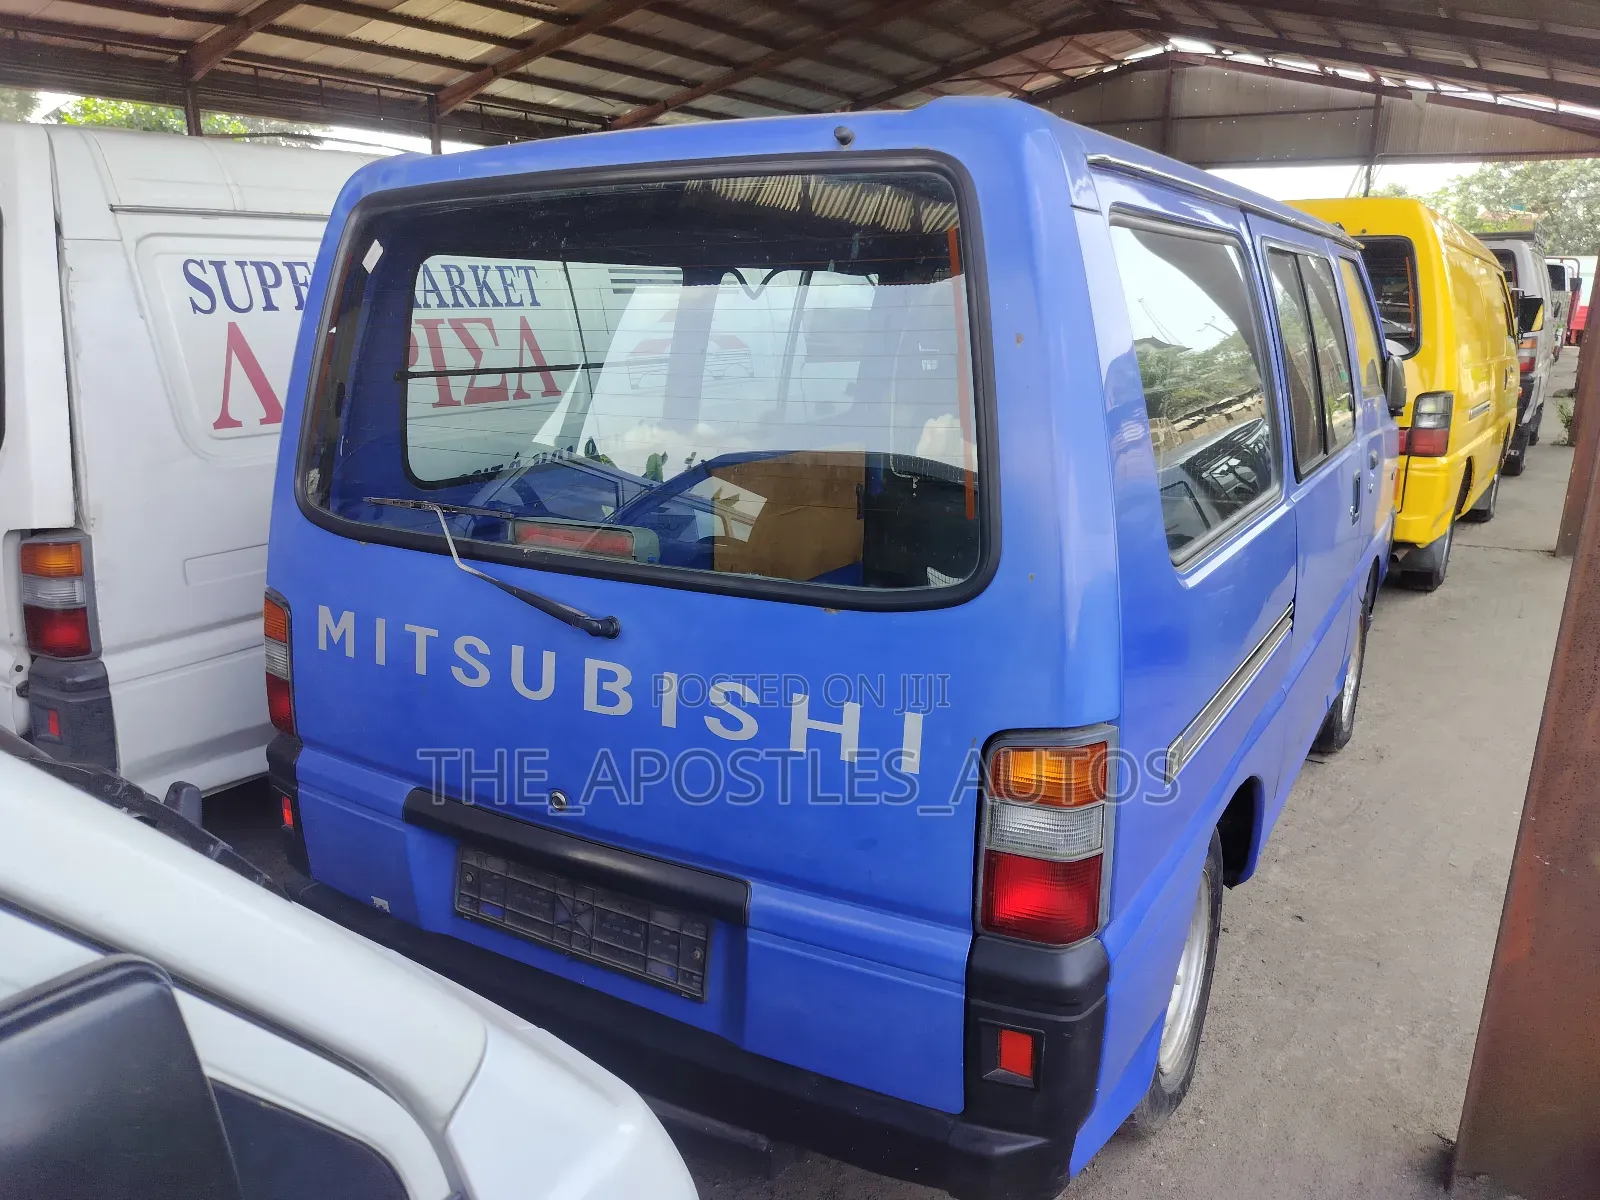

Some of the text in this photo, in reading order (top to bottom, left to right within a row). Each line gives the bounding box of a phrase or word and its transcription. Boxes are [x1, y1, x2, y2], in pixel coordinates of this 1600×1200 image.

[182, 258, 541, 315] SUPE ARKET
[317, 605, 924, 775] MITSUBISHI
